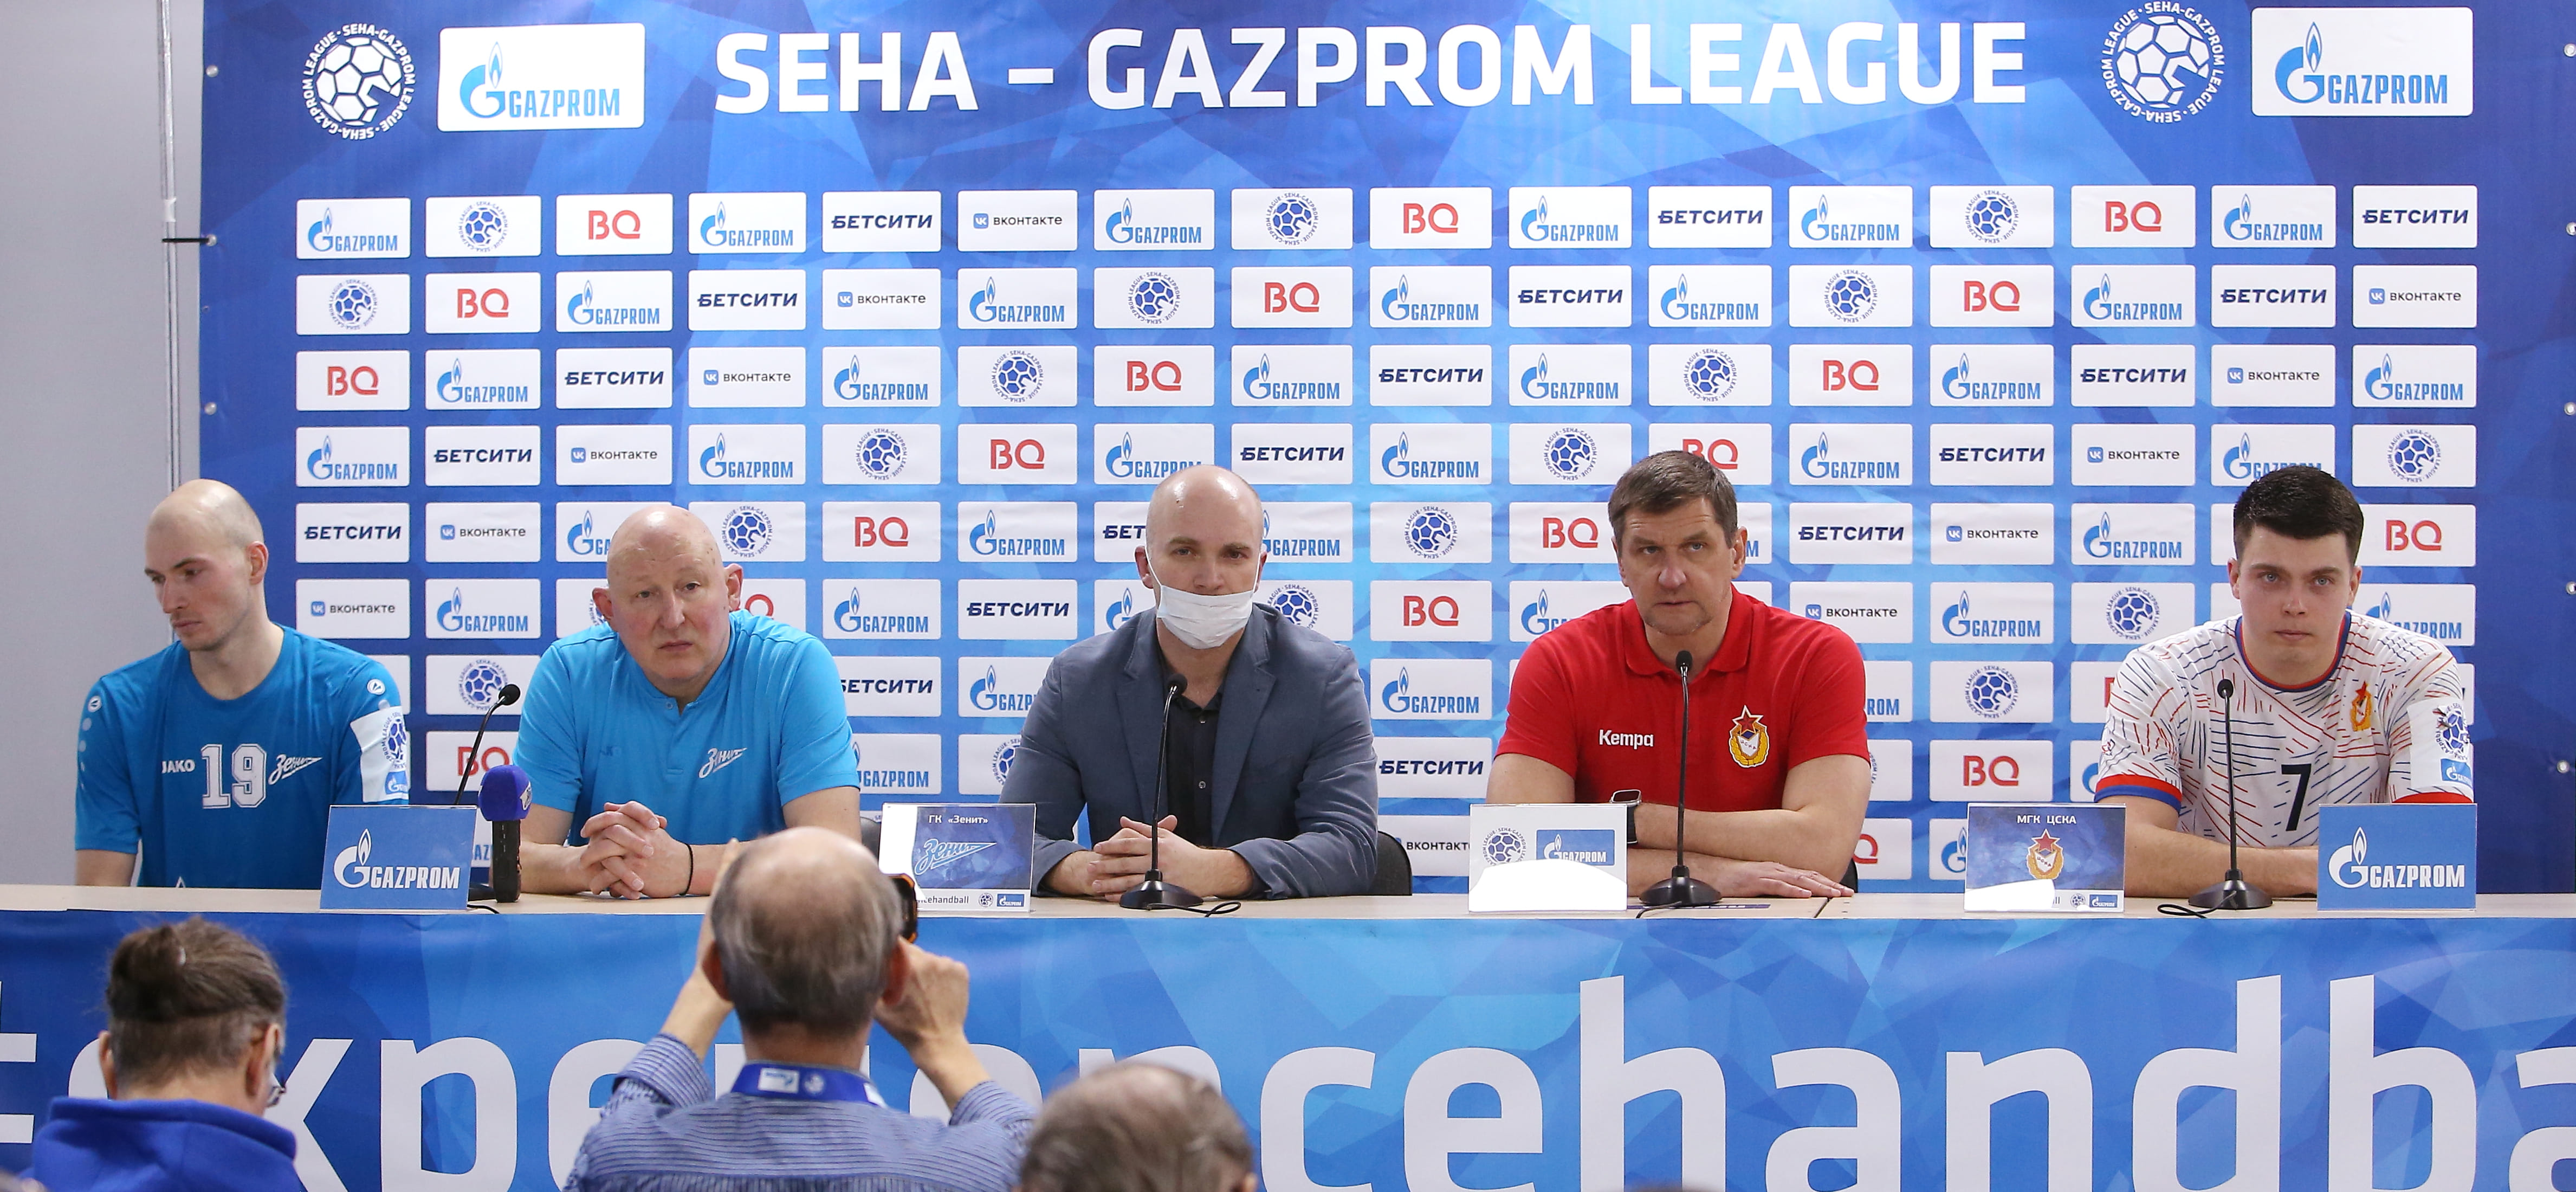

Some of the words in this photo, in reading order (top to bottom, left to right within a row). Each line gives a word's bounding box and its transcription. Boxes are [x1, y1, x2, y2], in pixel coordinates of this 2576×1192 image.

[2101, 8, 2139, 57] LEAGUE
[302, 30, 336, 77] LEAGUE
[2144, 1, 2225, 66] SEHA-GAZPROM
[2187, 67, 2225, 117] LEAGUE
[714, 31, 979, 114] SEHA
[1087, 24, 1594, 109] GAZPROM
[1630, 21, 2026, 105] LEAGUE
[342, 23, 416, 85] SEHA-GAZPROM
[382, 87, 416, 134] LEAGUE
[2328, 74, 2448, 104] GAZPROM
[509, 89, 619, 118] GAZPROM
[588, 209, 641, 240] BQ
[831, 214, 933, 229] БЕТСИТИ
[993, 216, 1063, 225] вконтакте
[1403, 203, 1459, 234] BQ
[1657, 210, 1763, 224] БЕТСИТИ
[2105, 201, 2162, 233] BQ
[2361, 209, 2469, 224] БЕТСИТИ
[728, 229, 793, 247] GAZPROM
[1135, 226, 1202, 244] GAZPROM
[1550, 224, 1619, 242] GAZPROM
[1831, 224, 1899, 241] GAZPROM
[2254, 223, 2323, 241] GAZPROM
[335, 235, 398, 252] GAZPROM
[457, 288, 509, 319] BQ
[696, 293, 798, 307] БЕТСИТИ
[857, 295, 926, 304] вконтакте
[1264, 281, 1320, 313] BQ
[1517, 289, 1623, 304] БЕТСИТИ
[1964, 280, 2021, 312] BQ
[2220, 288, 2327, 304] БЕТСИТИ
[2390, 292, 2462, 301] вконтакте
[595, 307, 660, 325] GAZPROM
[998, 305, 1065, 323] GAZPROM
[1411, 304, 1479, 321] GAZPROM
[1690, 303, 1759, 320] GAZPROM
[2113, 303, 2182, 320] GAZPROM
[327, 365, 379, 396] BQ
[564, 371, 664, 386] БЕТСИТИ
[723, 373, 791, 382] вконтакте
[1127, 360, 1182, 392] BQ
[1378, 368, 1484, 383] БЕТСИТИ
[1822, 359, 1879, 391] BQ
[2080, 368, 2187, 383] БЕТСИТИ
[2248, 371, 2320, 381] вконтакте
[464, 385, 528, 403] GAZPROM
[862, 383, 928, 401] GAZPROM
[1272, 382, 1340, 400] GAZPROM
[1550, 382, 1619, 400] GAZPROM
[1972, 382, 2041, 400] GAZPROM
[2394, 383, 2463, 401] GAZPROM
[433, 448, 533, 463] БЕТСИТИ
[590, 450, 658, 460] вконтакте
[990, 439, 1045, 470] BQ
[1240, 447, 1344, 461] БЕТСИТИ
[1938, 447, 2046, 462] БЕТСИТИ
[2108, 450, 2180, 460] вконтакте
[334, 463, 397, 480] GAZPROM
[728, 461, 793, 478] GAZPROM
[1135, 461, 1201, 478] GAZPR
[1411, 461, 1479, 478] GAZPROM
[1831, 461, 1900, 479] GAZPROM
[303, 525, 402, 540] БЕТСИТИ
[459, 528, 526, 537] вконтакте
[855, 516, 909, 547] BQ
[1543, 517, 1598, 547] BQ
[1797, 526, 1905, 541] БЕТСИТИ
[1967, 530, 2039, 539] вконтакте
[2385, 519, 2443, 551] BQ
[998, 538, 1065, 556] GAZPROM
[1272, 539, 1340, 556] GAZPROM
[2113, 541, 2182, 559] GAZPROM
[329, 604, 396, 614] вконтакте
[966, 602, 1070, 617] БЕТСИТИ
[1403, 595, 1459, 627] BQ
[1826, 609, 1897, 617] вконтакте
[464, 615, 528, 632] GAZPROM
[862, 616, 929, 633] GAZPROM
[1972, 620, 2041, 637] GAZPROM
[1411, 696, 1479, 714] GAZPROM
[1599, 730, 1654, 750] Kempa
[161, 759, 195, 774] JAKO
[1379, 760, 1484, 774] БЕТСИТИ
[1963, 755, 2020, 787] BQ
[200, 744, 267, 809] 19
[864, 771, 929, 788] GAZPROM
[2281, 764, 2312, 832] 7
[929, 815, 942, 824] ГК
[948, 815, 988, 824] «Зенит»
[2017, 815, 2041, 824] МГК
[2047, 815, 2077, 826] ЦСКА
[1563, 851, 1606, 862] GAZPROM
[371, 866, 460, 889] GAZPROM
[2370, 865, 2465, 888] GAZPROM
